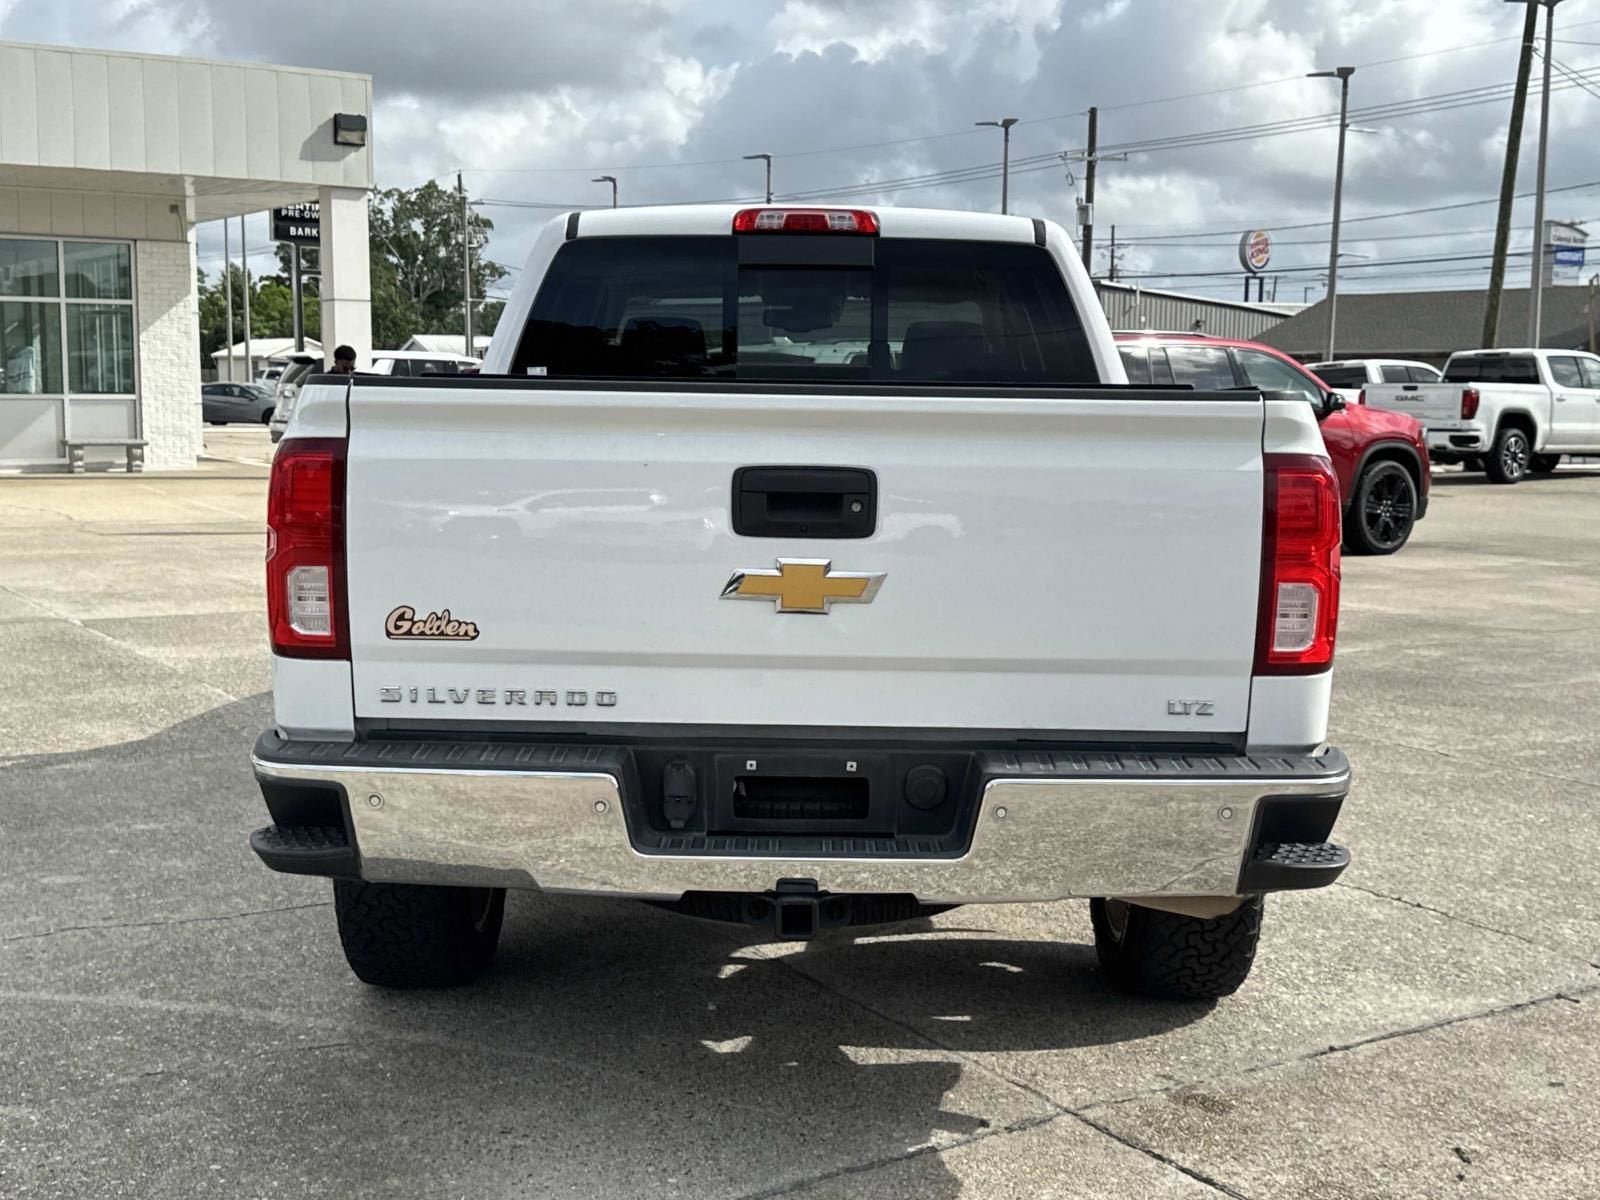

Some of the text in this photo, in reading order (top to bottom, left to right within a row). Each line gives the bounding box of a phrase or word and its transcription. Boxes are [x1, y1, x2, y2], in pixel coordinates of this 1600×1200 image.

[290, 226, 319, 238] BARK
[385, 605, 479, 641] Golden
[380, 685, 618, 707] SILVERADO
[1167, 698, 1215, 716] LTZ
